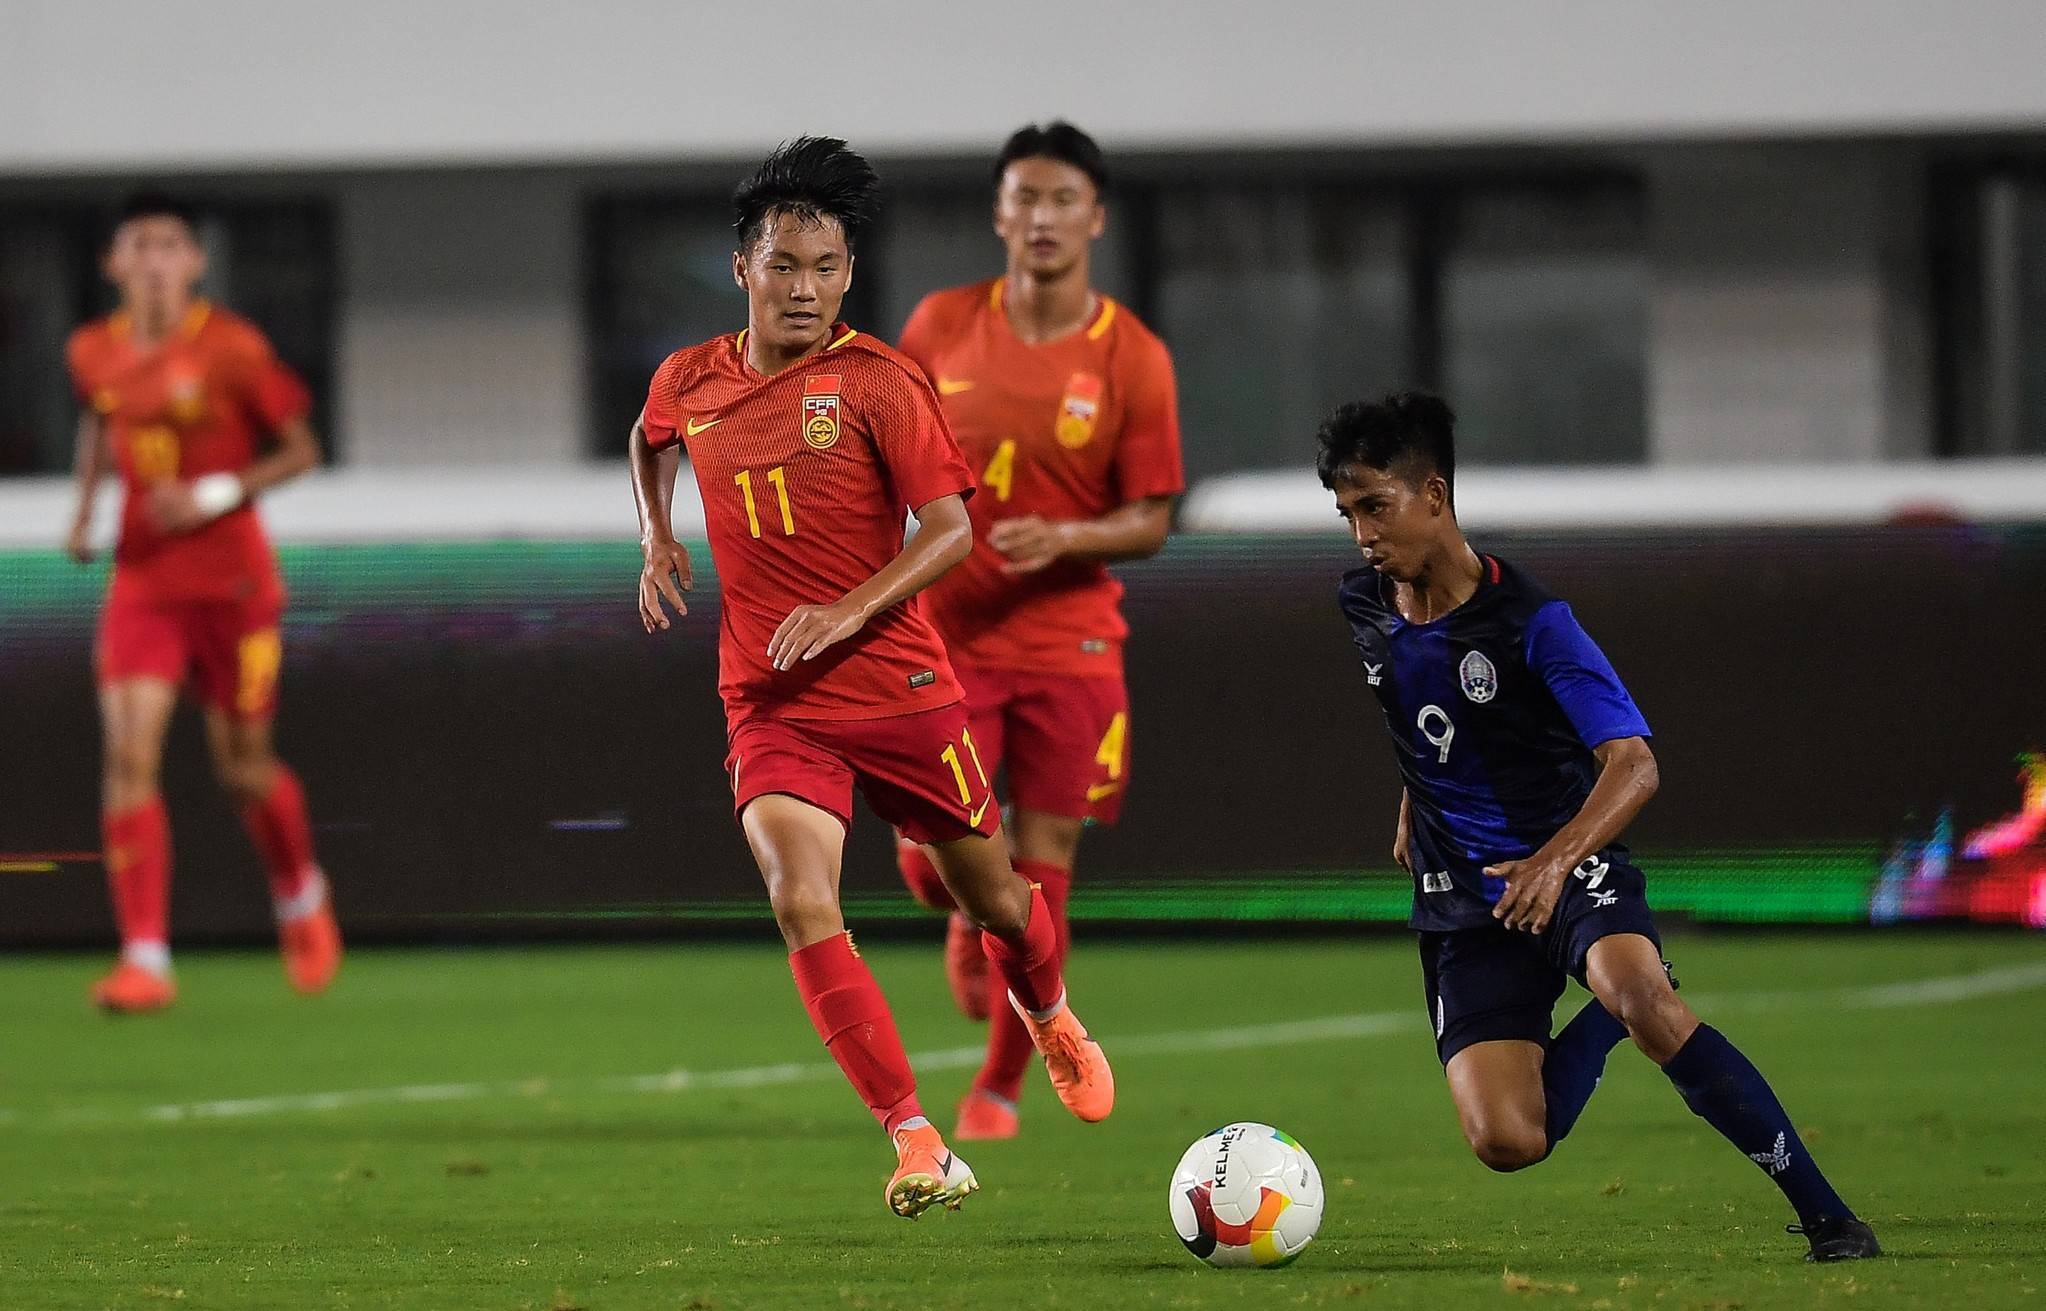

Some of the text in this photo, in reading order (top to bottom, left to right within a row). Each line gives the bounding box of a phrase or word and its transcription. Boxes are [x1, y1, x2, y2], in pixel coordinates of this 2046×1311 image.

[806, 400, 836, 410] CFA
[985, 439, 1017, 501] 4
[734, 466, 795, 538] 11
[1095, 712, 1127, 779] 4
[1417, 704, 1455, 763] 9
[941, 726, 988, 805] 11
[1573, 855, 1609, 889] 9
[1214, 1133, 1235, 1188] KELME
